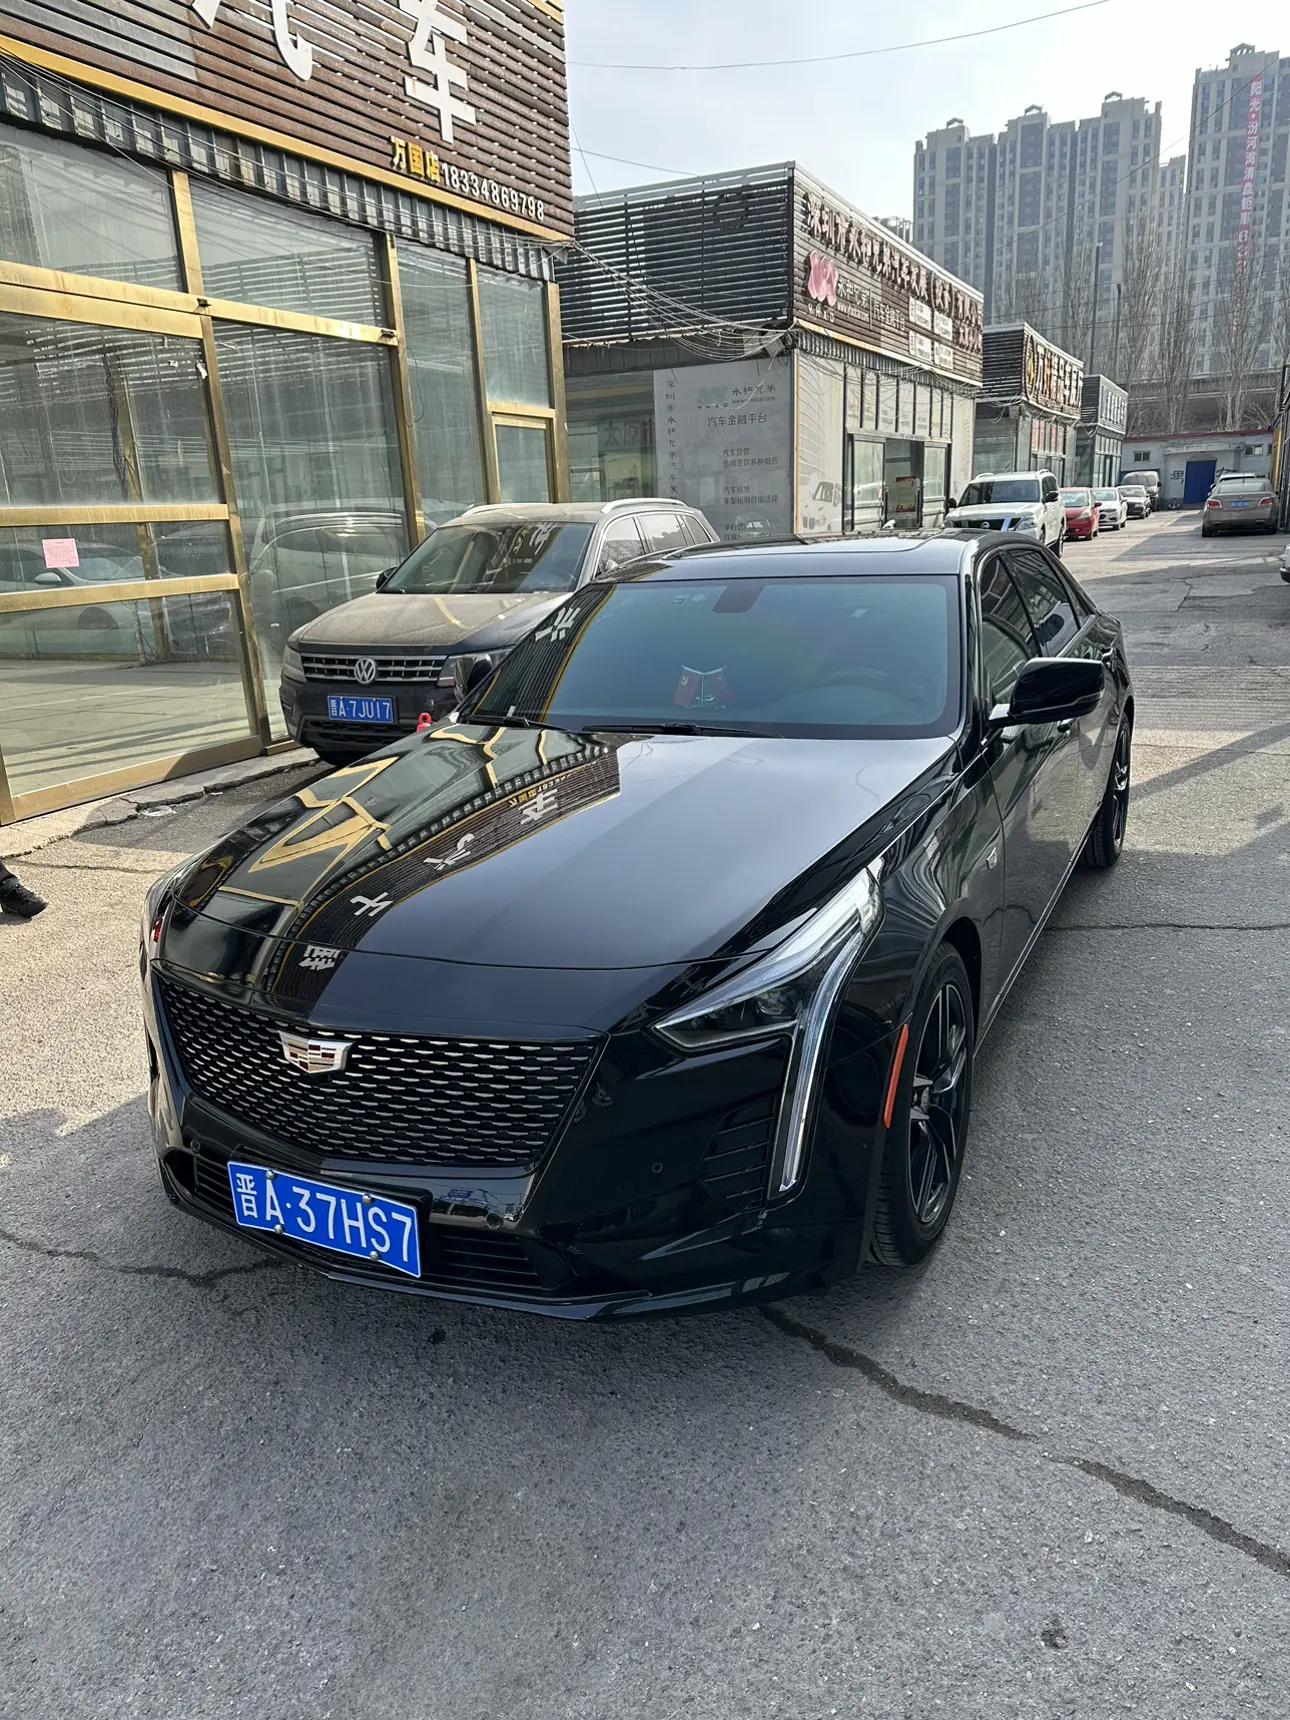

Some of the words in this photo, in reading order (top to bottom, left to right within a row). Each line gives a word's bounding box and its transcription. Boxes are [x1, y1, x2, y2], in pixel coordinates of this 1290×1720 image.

[390, 135, 441, 183] 万国店
[441, 162, 545, 221] 18334869798
[732, 383, 776, 396] 永和兄弟
[707, 413, 767, 427] 汽车金融平台
[722, 447, 750, 457] 汽车贷款
[236, 1173, 413, 1262] 晋A·37HS7
